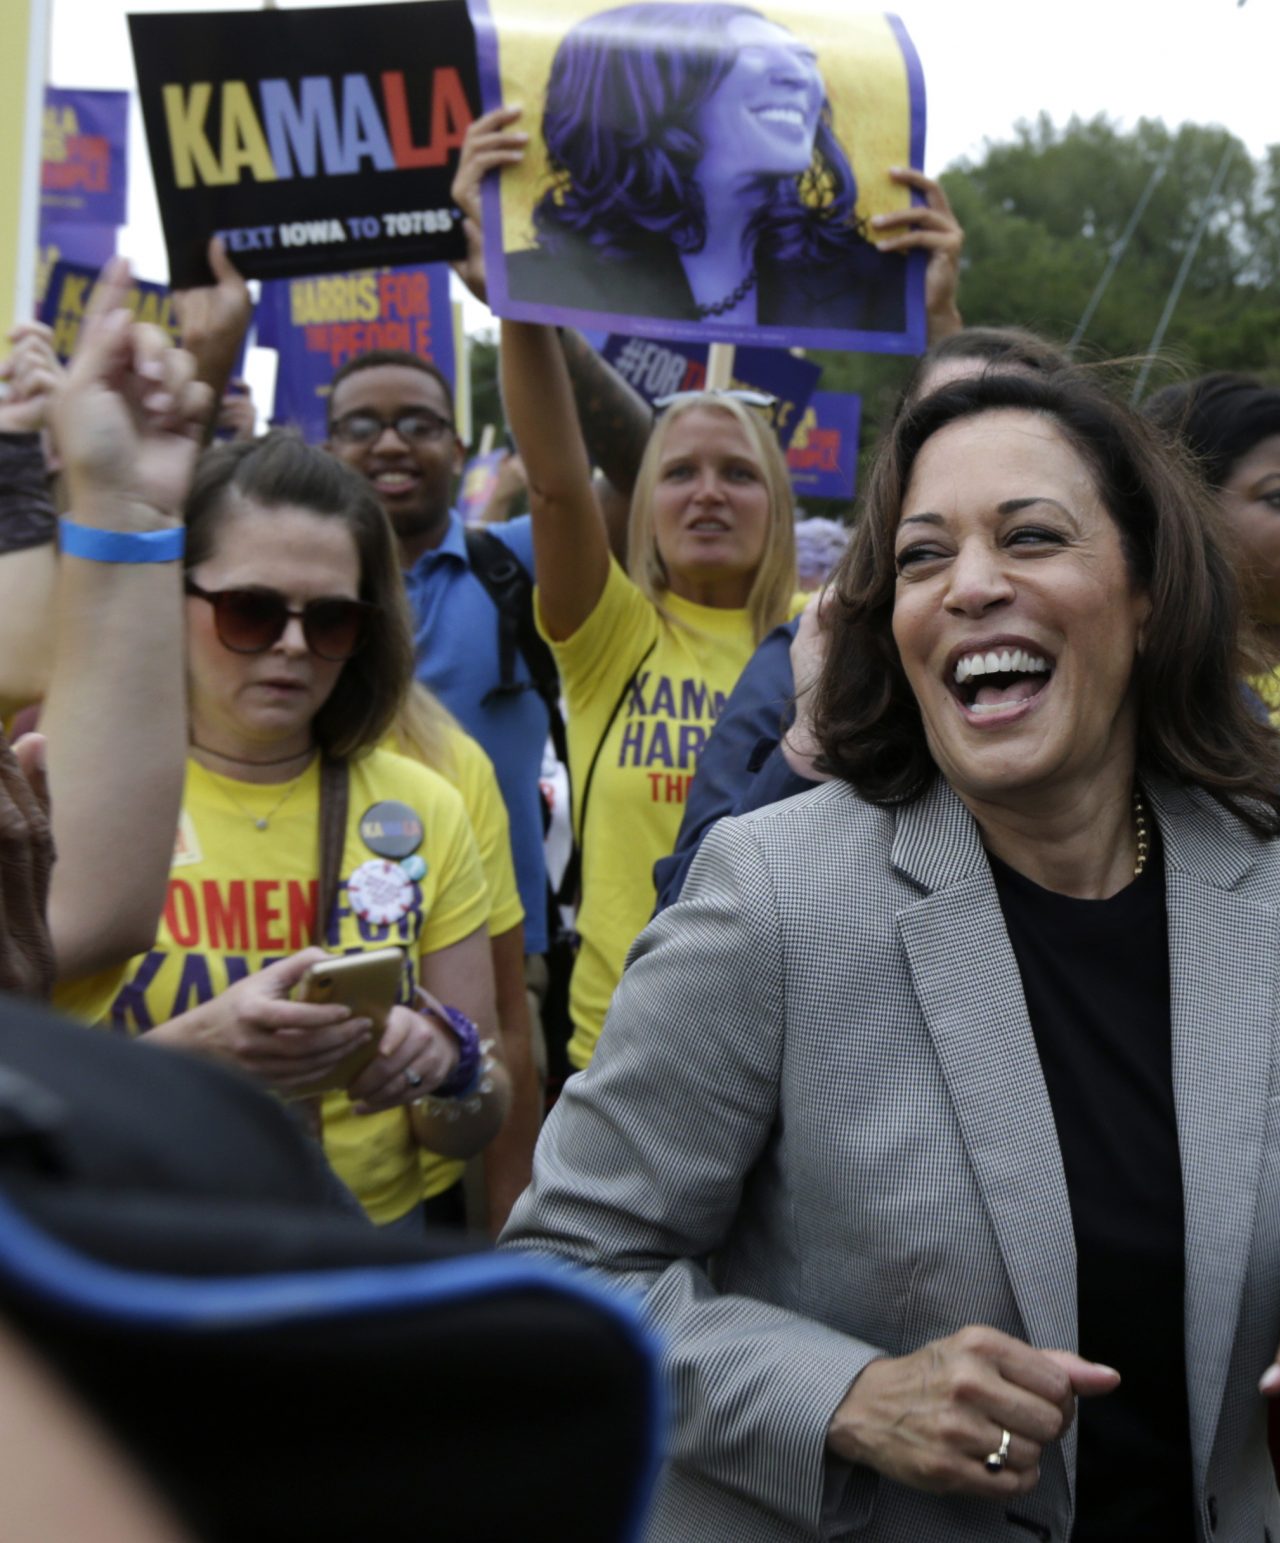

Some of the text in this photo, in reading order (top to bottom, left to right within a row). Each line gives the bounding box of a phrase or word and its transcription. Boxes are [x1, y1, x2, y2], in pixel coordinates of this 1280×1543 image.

[162, 66, 476, 189] KAMALA
[213, 226, 276, 252] TEXT
[278, 219, 346, 248] IOWA
[347, 216, 381, 240] TO
[163, 878, 320, 951] OMEN
